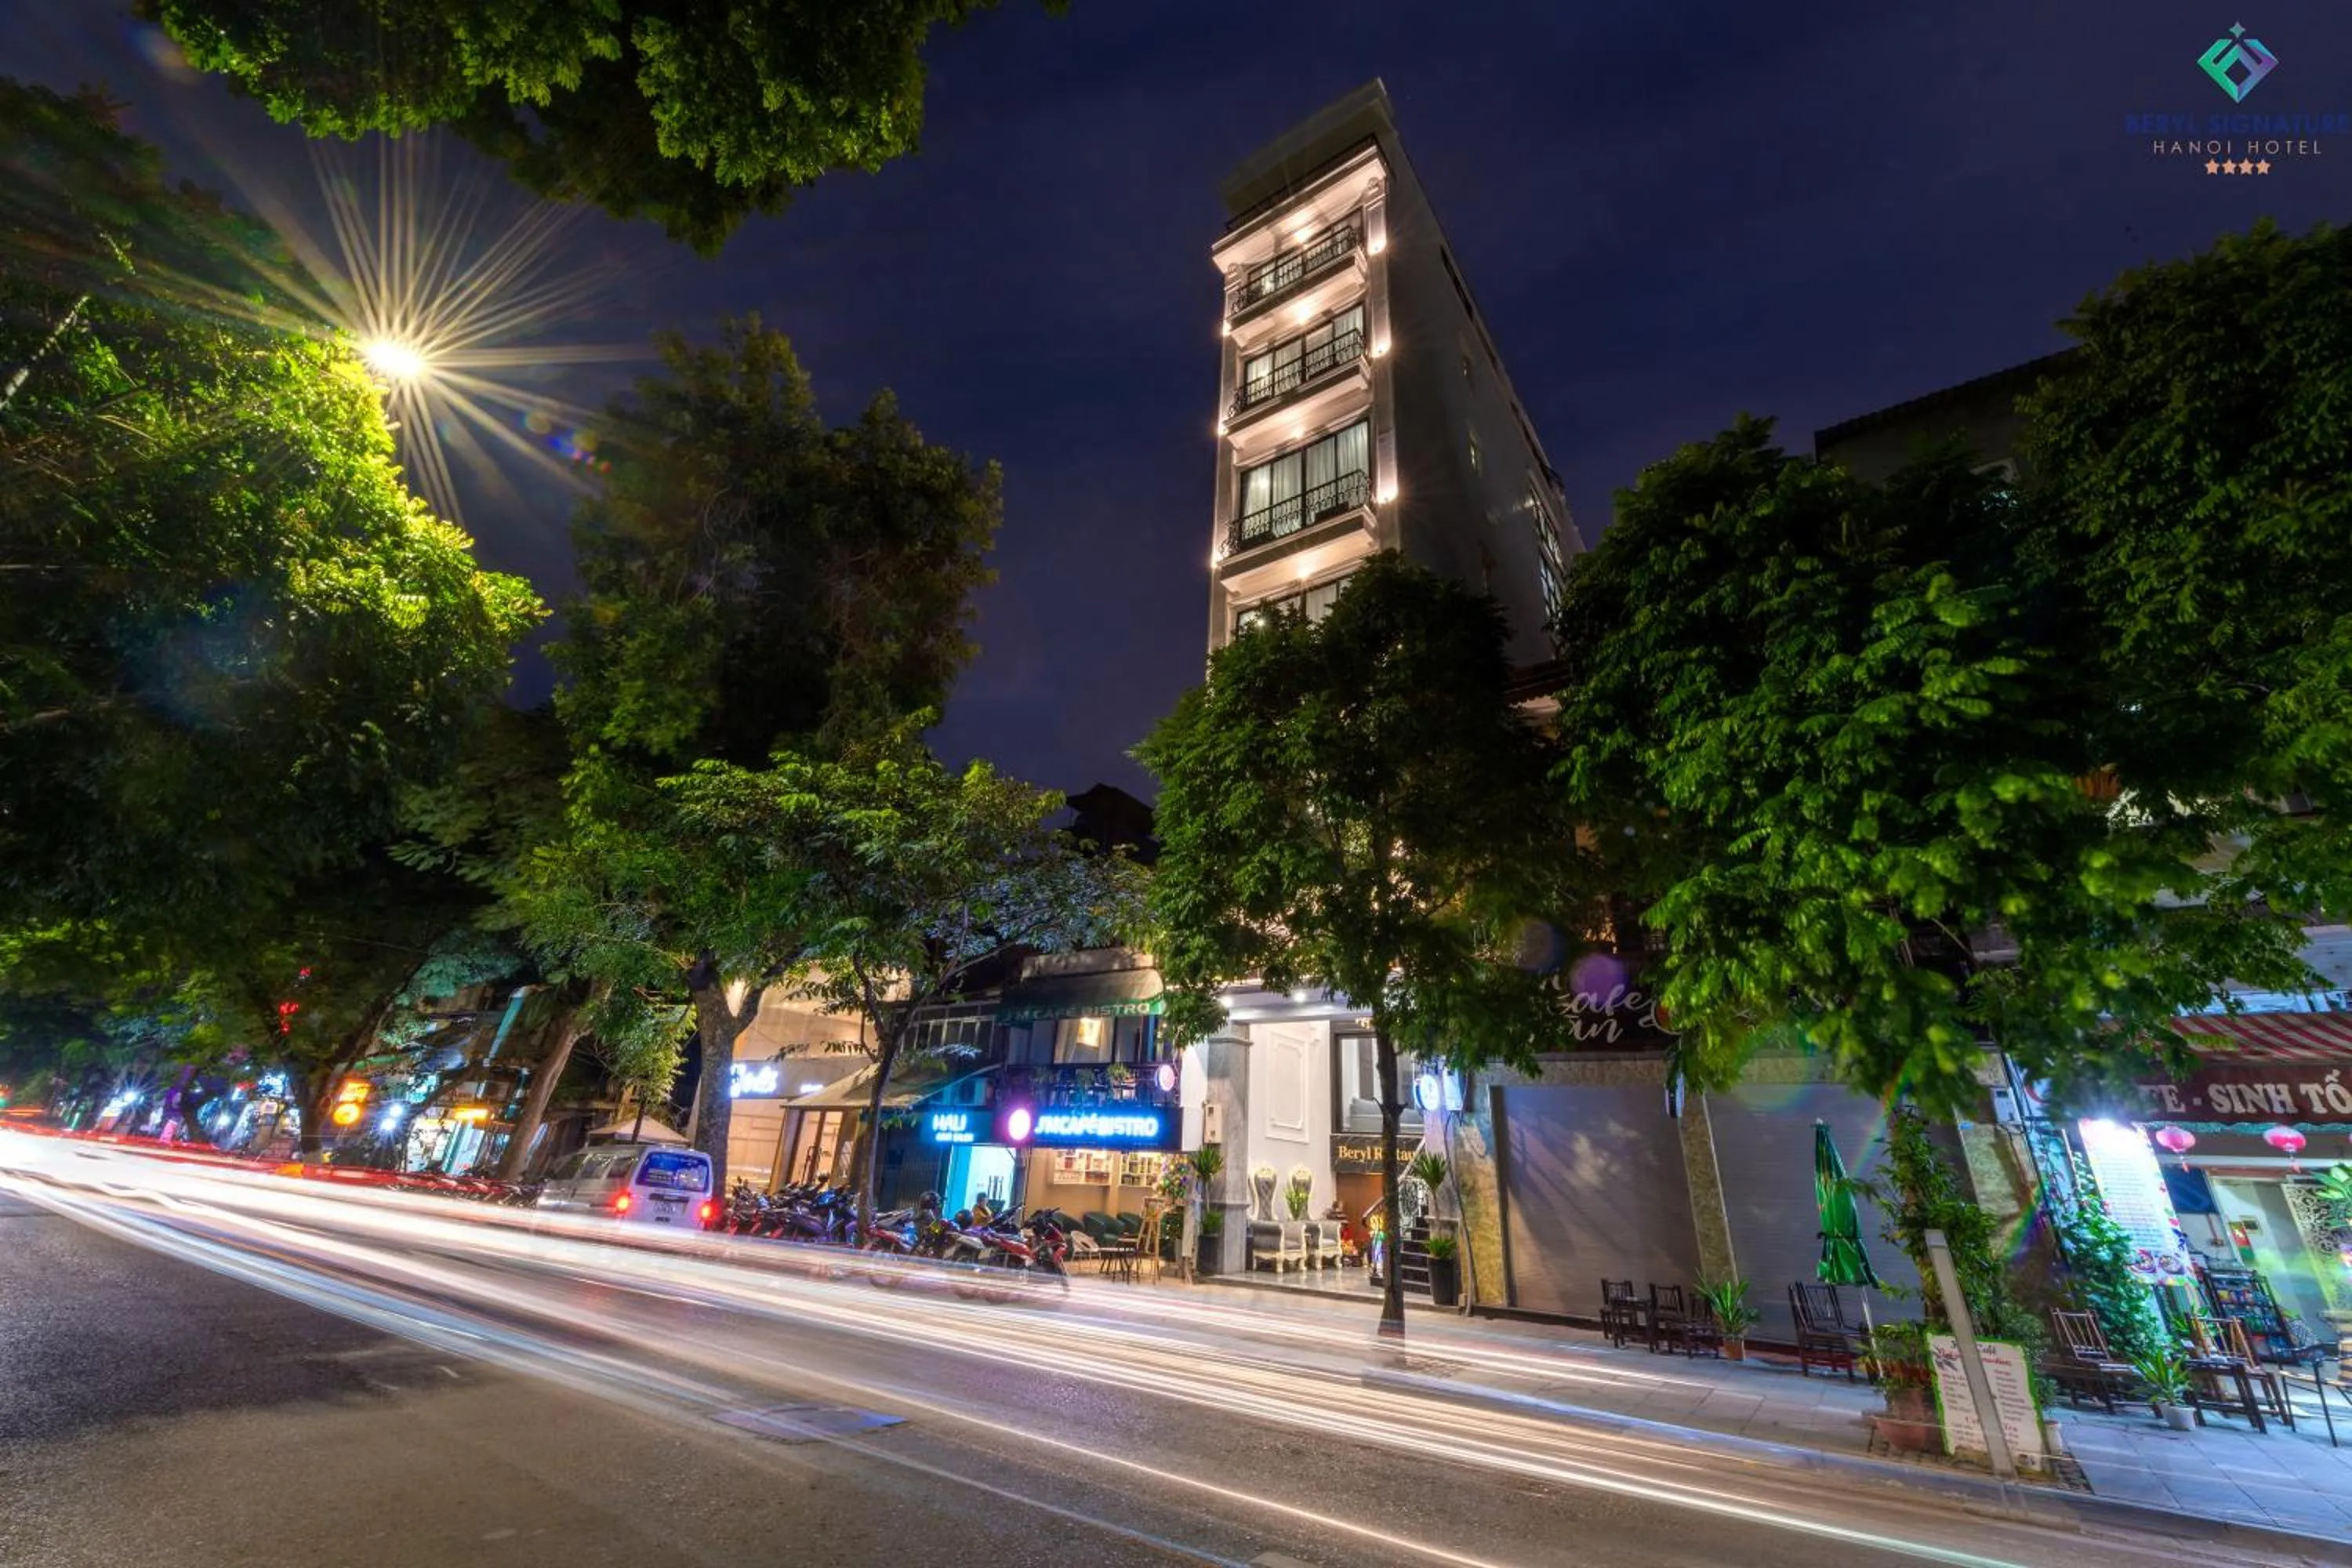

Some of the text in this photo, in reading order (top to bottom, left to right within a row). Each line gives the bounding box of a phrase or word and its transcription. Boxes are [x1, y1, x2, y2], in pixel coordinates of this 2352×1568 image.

[2208, 1083, 2298, 1114] SINH
[2299, 1069, 2352, 1114] TỐ
[1338, 1145, 1371, 1163] Beryl
